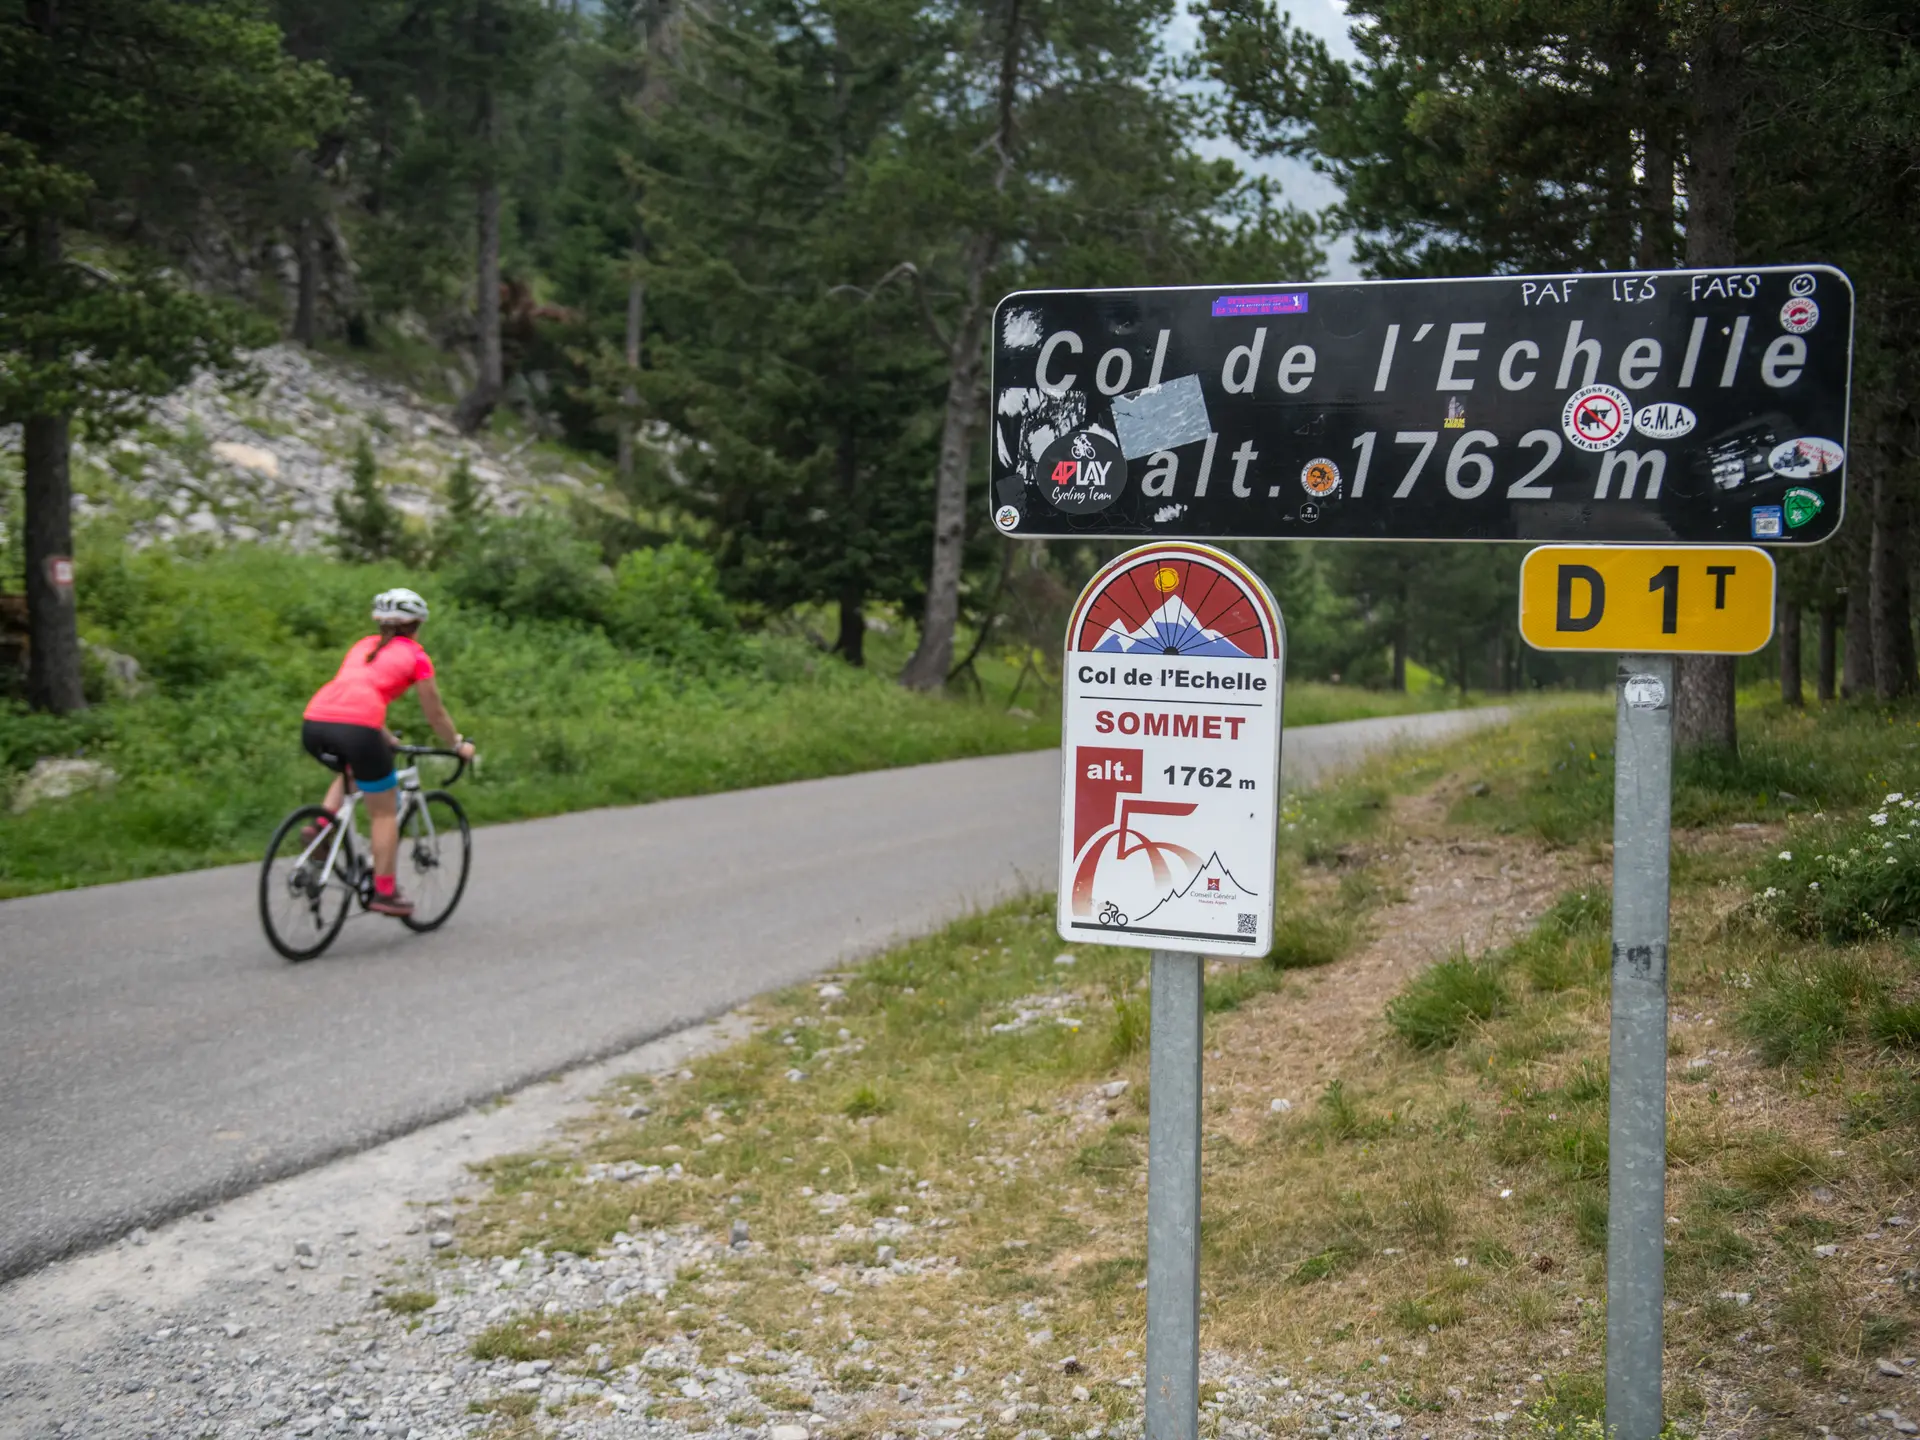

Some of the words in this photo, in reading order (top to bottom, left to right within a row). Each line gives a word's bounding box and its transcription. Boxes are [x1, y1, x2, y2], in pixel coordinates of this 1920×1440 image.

[1521, 279, 1578, 306] PAF
[1612, 275, 1659, 303] LES
[1690, 274, 1761, 302] FAFS
[1034, 328, 1171, 397] Col
[1221, 327, 1317, 395] de
[1373, 316, 1808, 394] l'Echelle
[1563, 386, 1603, 428] MOTO-CROSS
[1604, 387, 1631, 426] FAN-CLUB
[1640, 404, 1691, 431] G.M.A.
[1571, 431, 1625, 450] GRAUSAM
[1051, 461, 1112, 486] 4PLAY
[1140, 431, 1281, 499] alt.
[1350, 429, 1564, 500] 1762
[1593, 448, 1668, 500] m
[1052, 485, 1086, 505] Cycling
[1088, 485, 1112, 501] Team
[1555, 564, 1606, 632] D
[1078, 665, 1117, 685] Col
[1123, 668, 1153, 687] de
[1160, 669, 1267, 692] l'Echelle
[1095, 710, 1246, 741] SOMMET
[1086, 760, 1133, 782] alt.
[1163, 765, 1233, 789] 1762
[1238, 778, 1256, 790] m
[1190, 891, 1212, 899] Conseil
